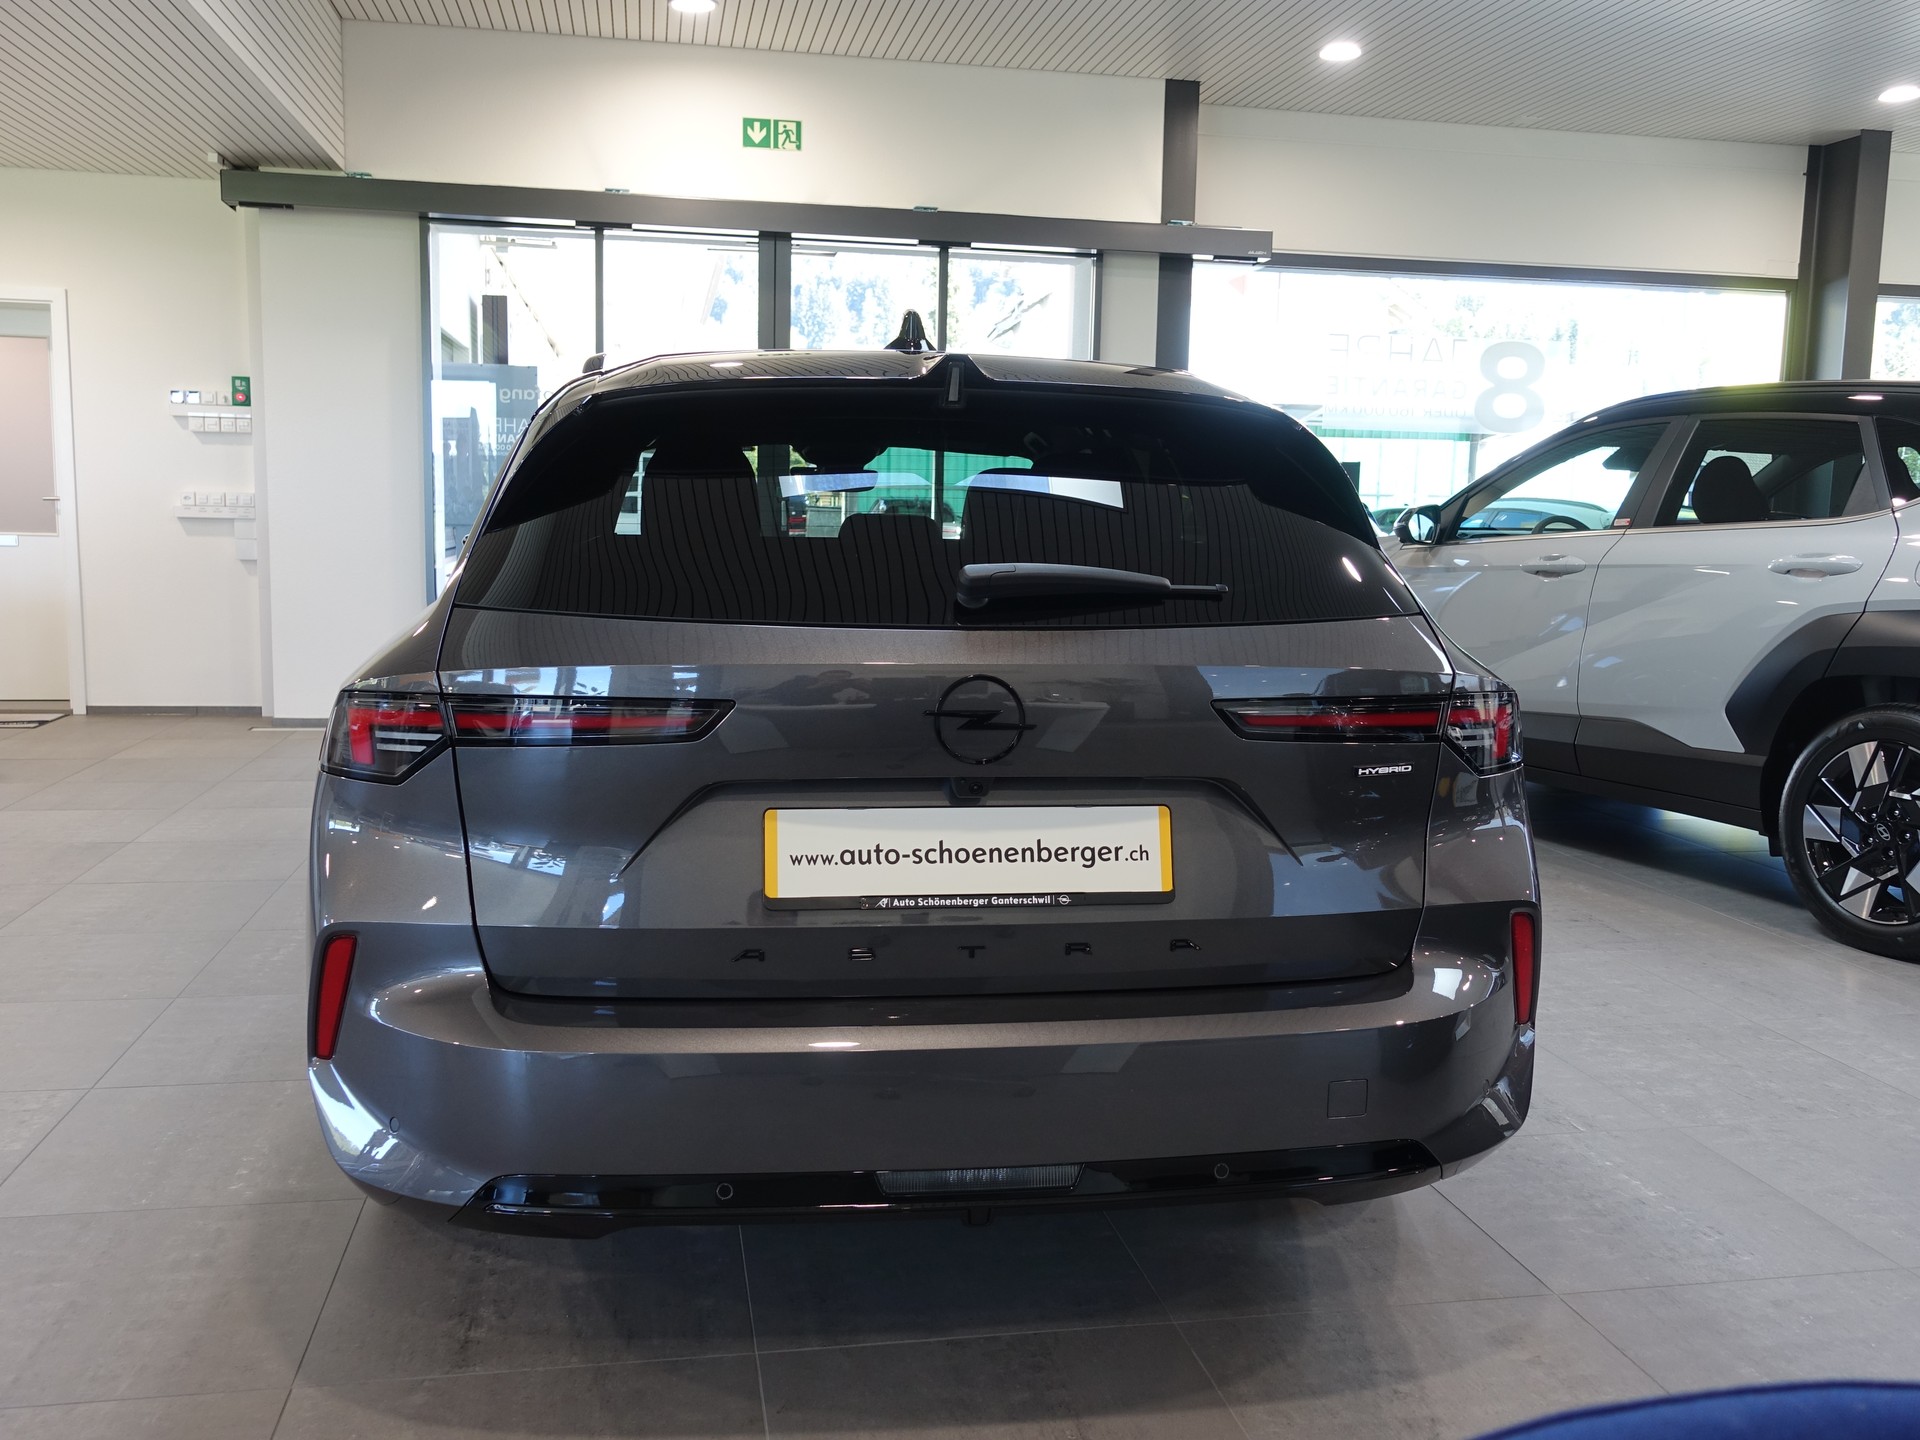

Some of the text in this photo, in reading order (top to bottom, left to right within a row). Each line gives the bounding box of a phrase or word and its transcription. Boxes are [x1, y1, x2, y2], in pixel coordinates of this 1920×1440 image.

[1358, 765, 1412, 775] HYBRID
[790, 839, 1150, 868] www.auto-schoenenberger.ch
[893, 895, 1051, 906] Auto Schönenberger Ganterschwil
[731, 938, 1201, 962] ASTRA
